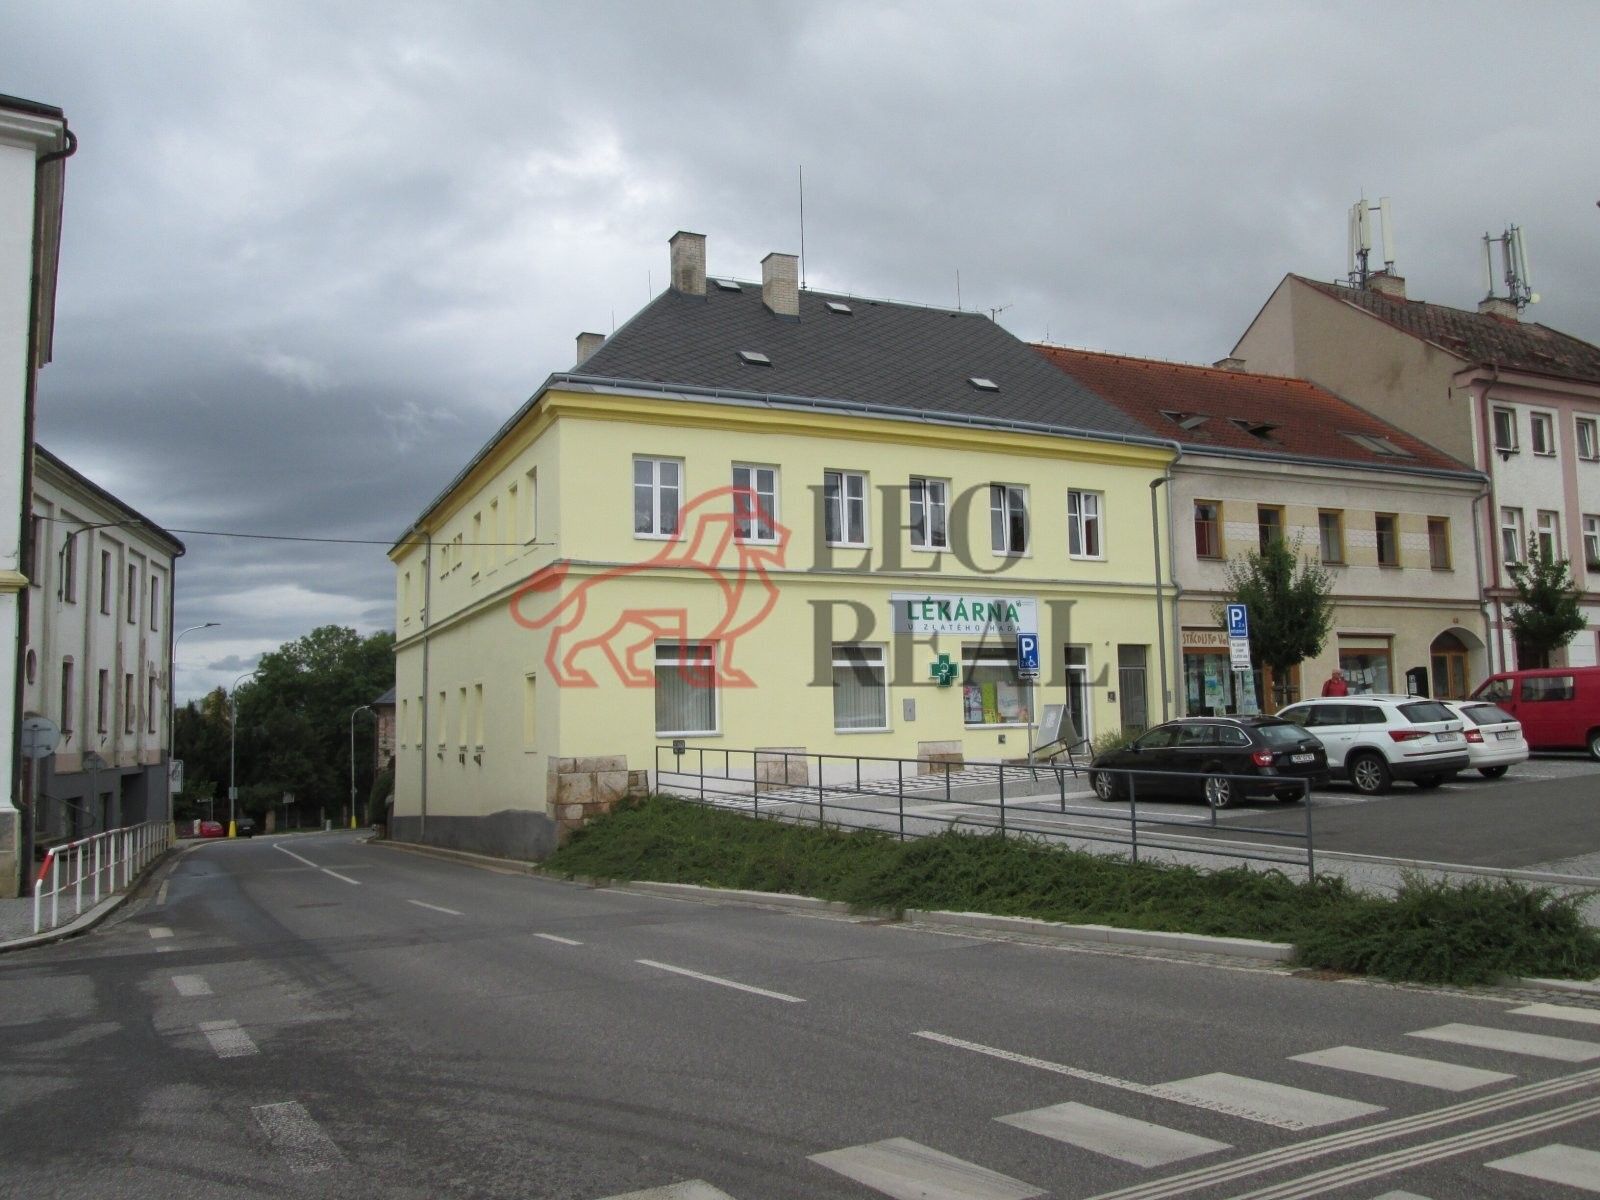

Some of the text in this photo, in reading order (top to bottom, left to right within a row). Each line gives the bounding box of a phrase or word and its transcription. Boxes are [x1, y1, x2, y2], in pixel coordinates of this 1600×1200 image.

[907, 596, 1020, 623] LÉKÁRNA
[1231, 608, 1242, 628] P
[924, 623, 980, 632] ZLATÉHO
[989, 624, 1021, 632] HADA
[1021, 637, 1034, 659] P
